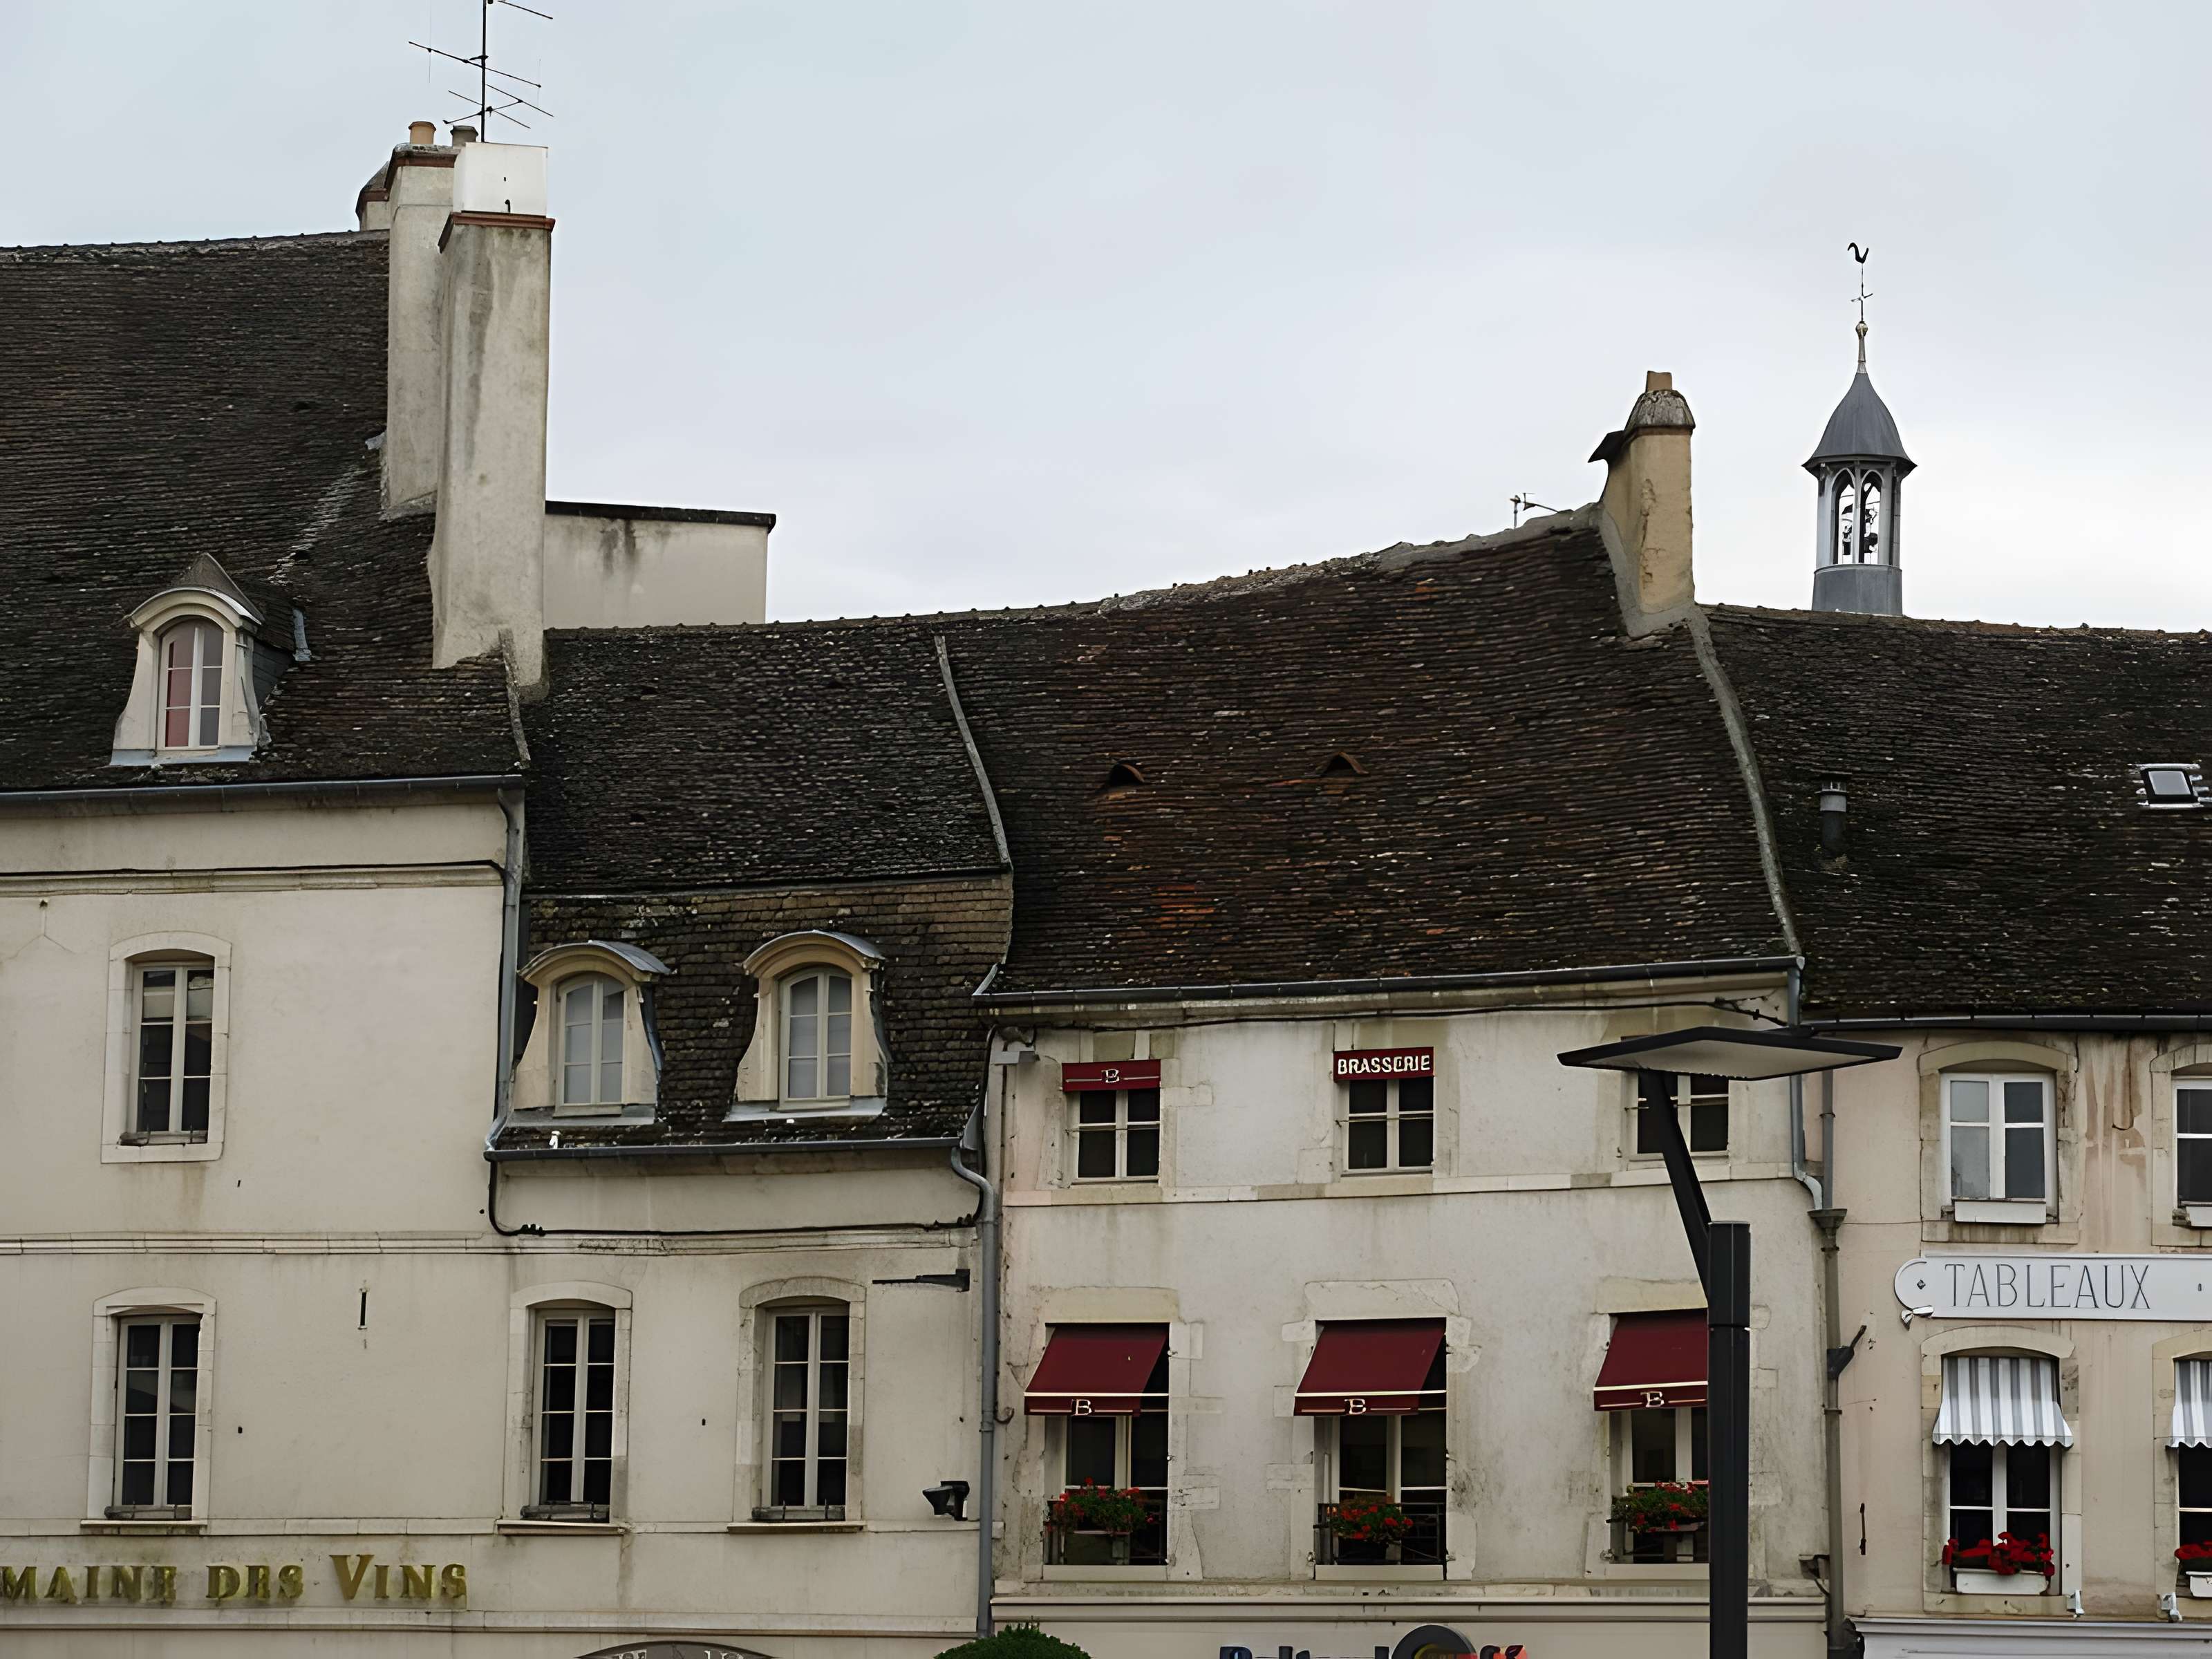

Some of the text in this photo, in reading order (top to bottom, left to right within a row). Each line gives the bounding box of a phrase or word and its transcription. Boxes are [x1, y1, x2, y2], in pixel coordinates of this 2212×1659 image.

[1338, 1055, 1430, 1075] BRASSERIE
[1944, 1264, 2150, 1309] TABLEAUX
[1071, 1398, 1092, 1416] B
[1344, 1398, 1367, 1415] B
[1640, 1391, 1665, 1408] B
[206, 1565, 303, 1599] DES
